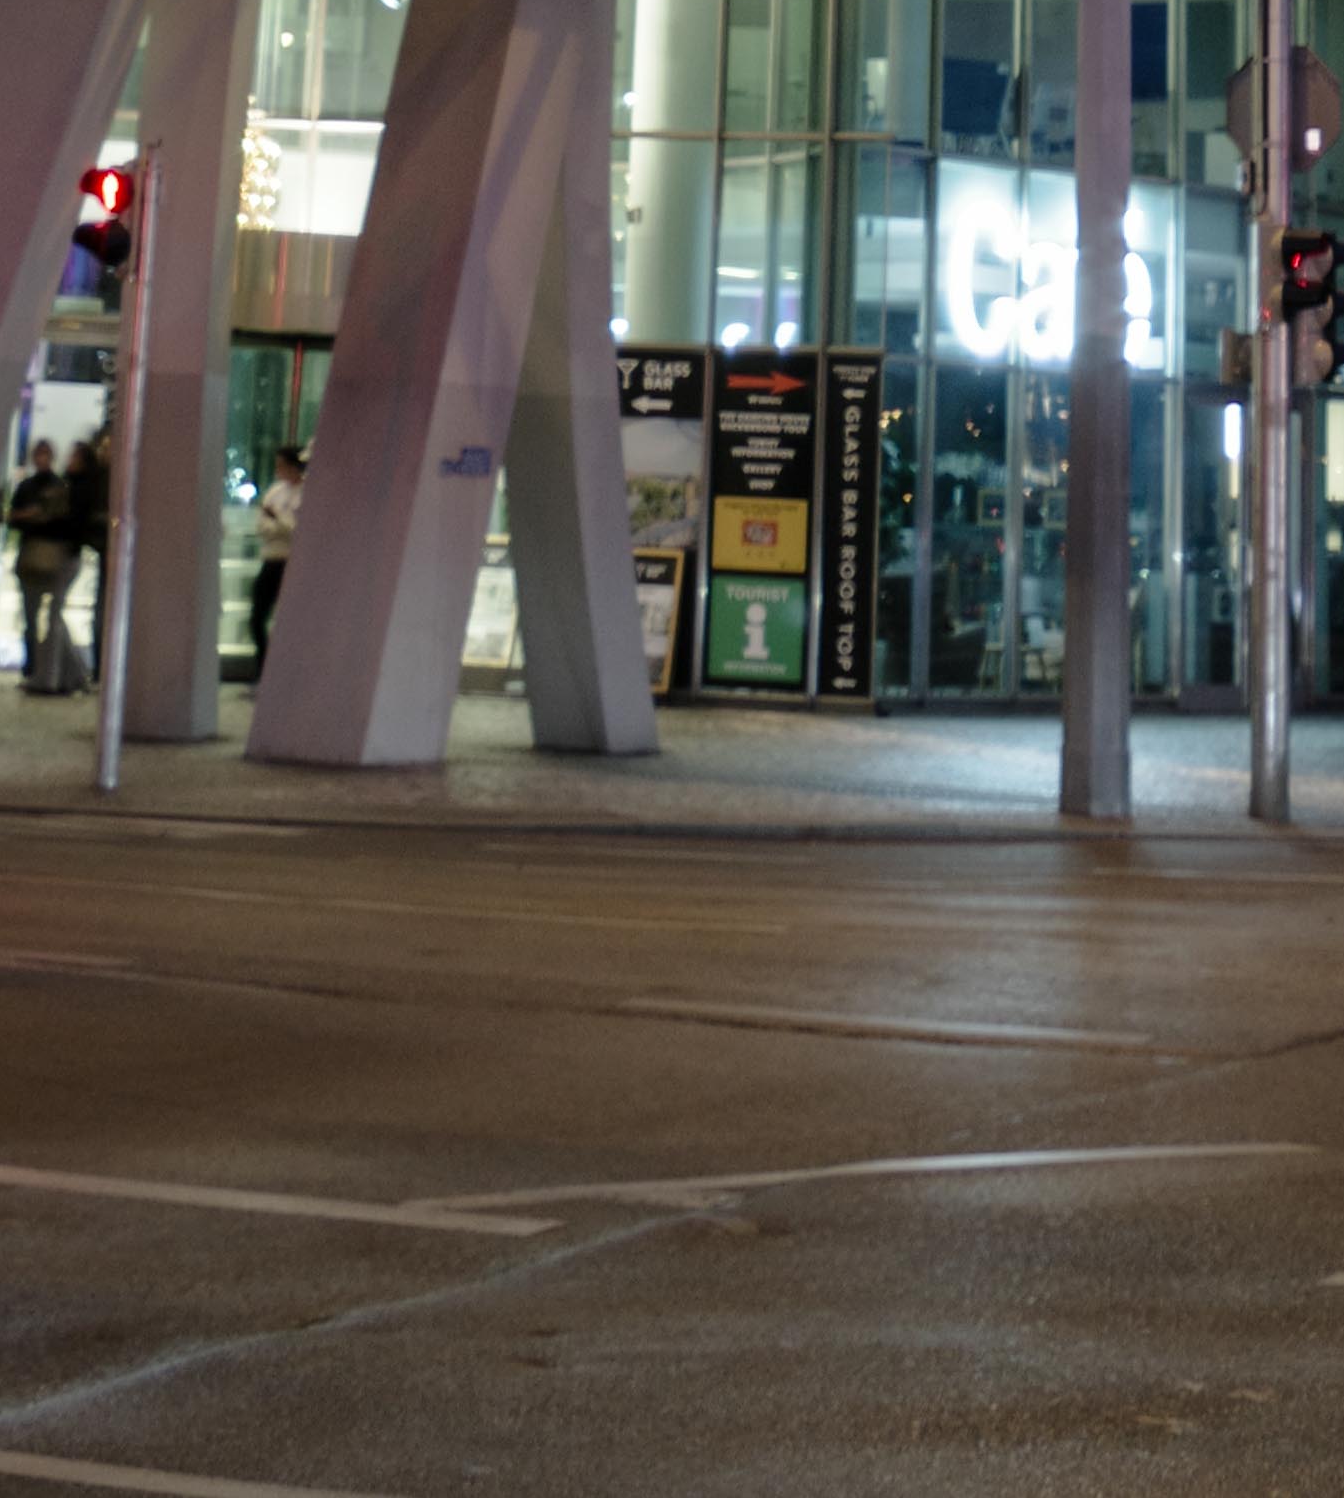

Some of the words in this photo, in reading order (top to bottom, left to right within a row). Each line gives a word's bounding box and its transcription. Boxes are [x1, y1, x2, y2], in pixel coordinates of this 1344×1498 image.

[643, 360, 692, 379] GLASS
[643, 376, 674, 391] BAR
[842, 405, 861, 483] GLASS
[840, 489, 859, 538] BAR
[726, 585, 790, 604] TOURIST
[838, 545, 857, 614] ROOF
[836, 624, 856, 672] TOP
